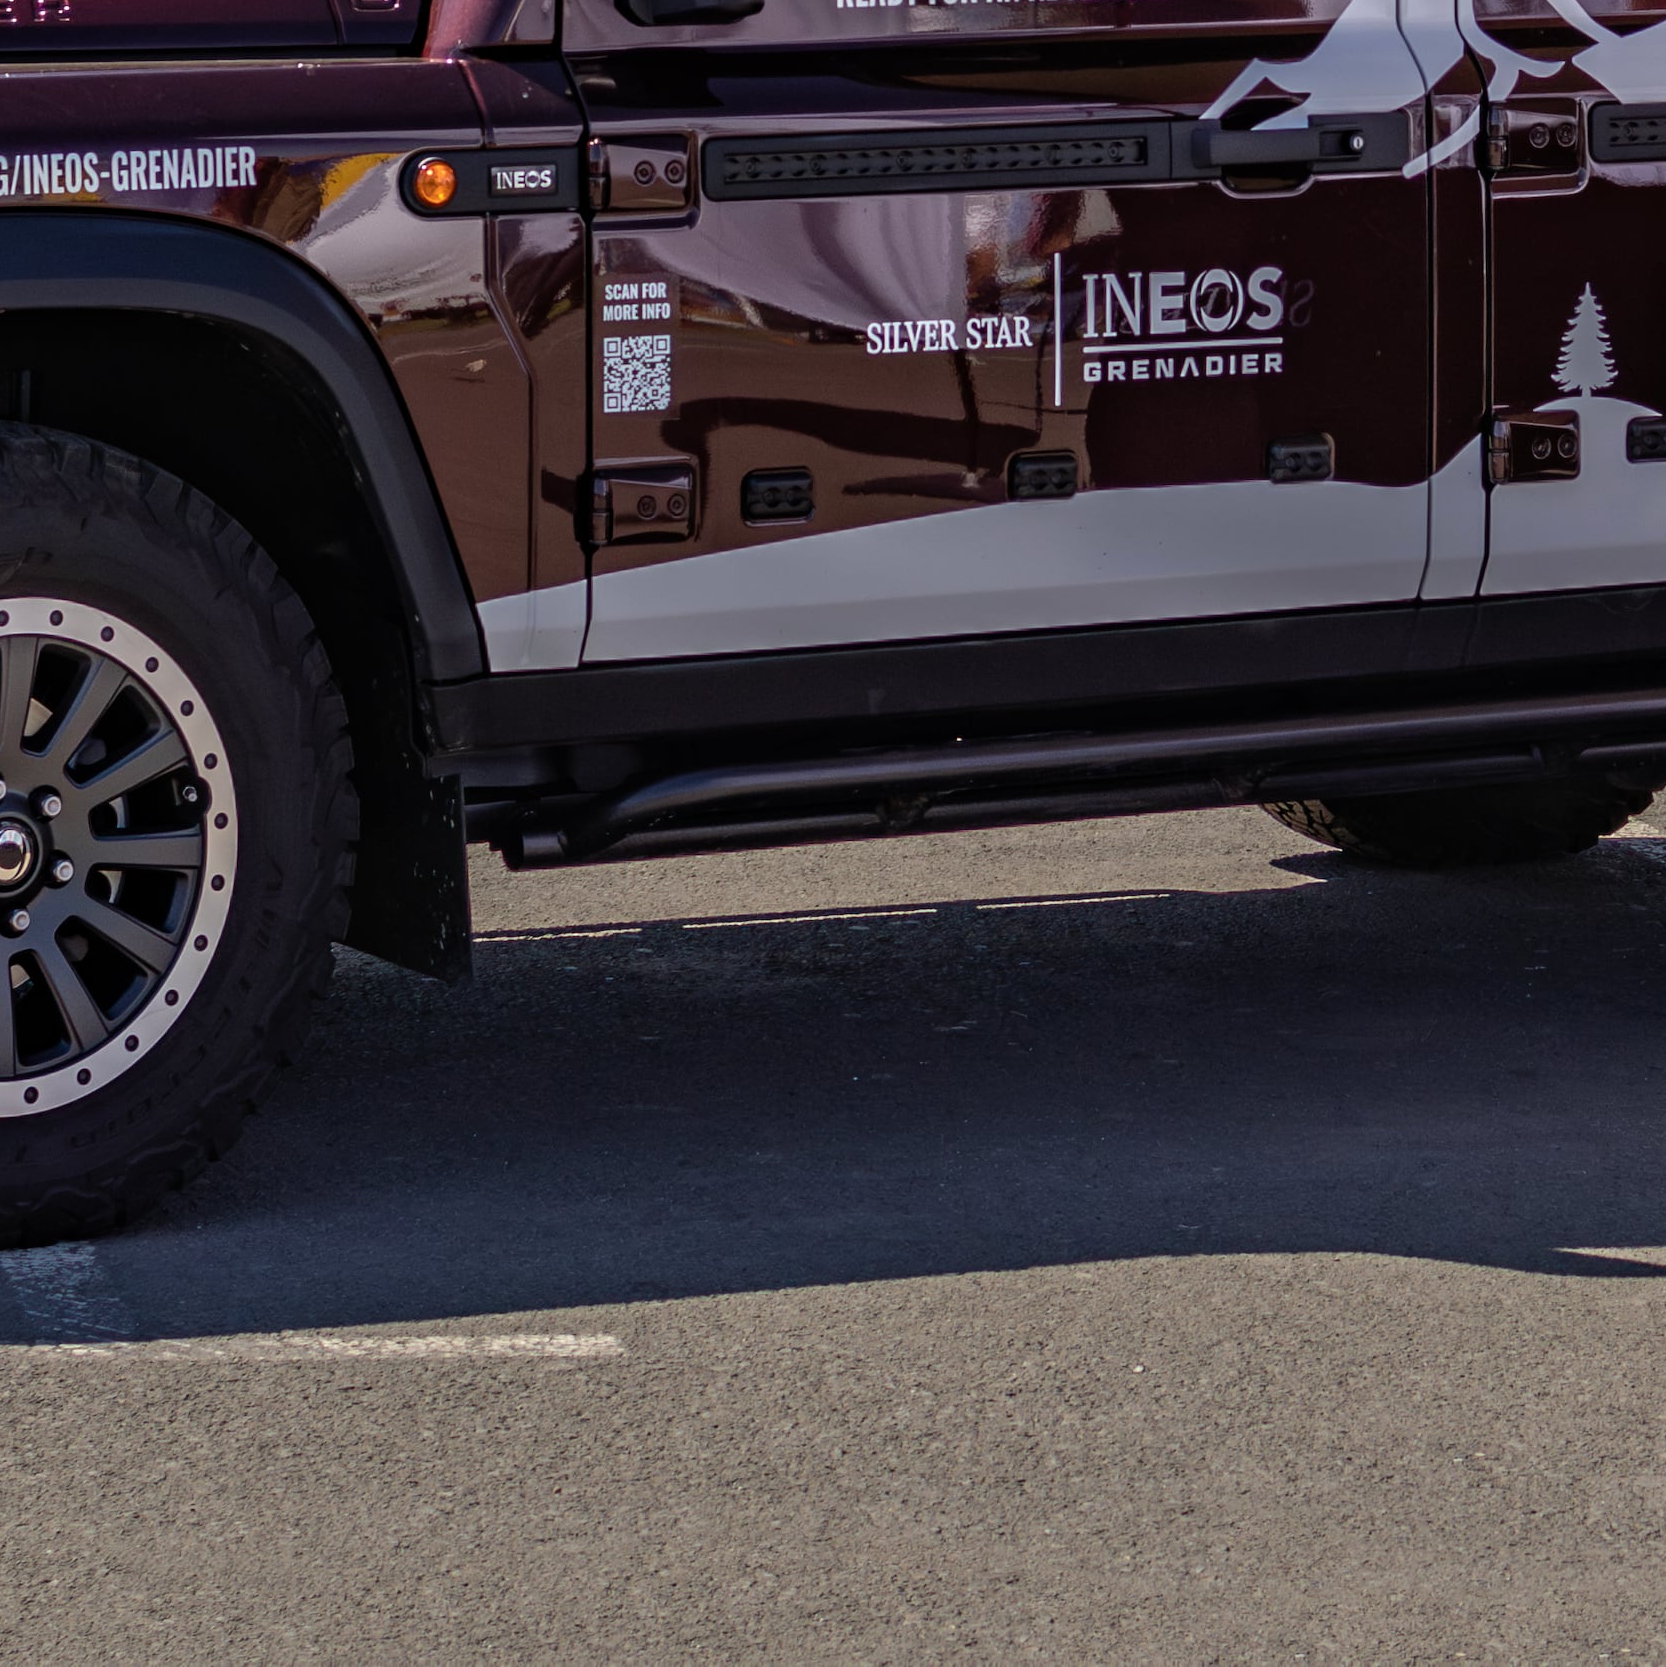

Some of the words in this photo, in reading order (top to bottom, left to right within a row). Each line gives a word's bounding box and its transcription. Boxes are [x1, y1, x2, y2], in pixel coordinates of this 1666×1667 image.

[496, 169, 552, 190] INEOS
[604, 283, 639, 301] SCAN
[642, 282, 667, 299] FOR
[1082, 266, 1284, 339] INEOS
[603, 304, 639, 322] MORE
[642, 302, 671, 320] INFO
[866, 318, 959, 355] SILVER
[966, 315, 1034, 351] STAR
[1083, 352, 1284, 383] GRENADIER
